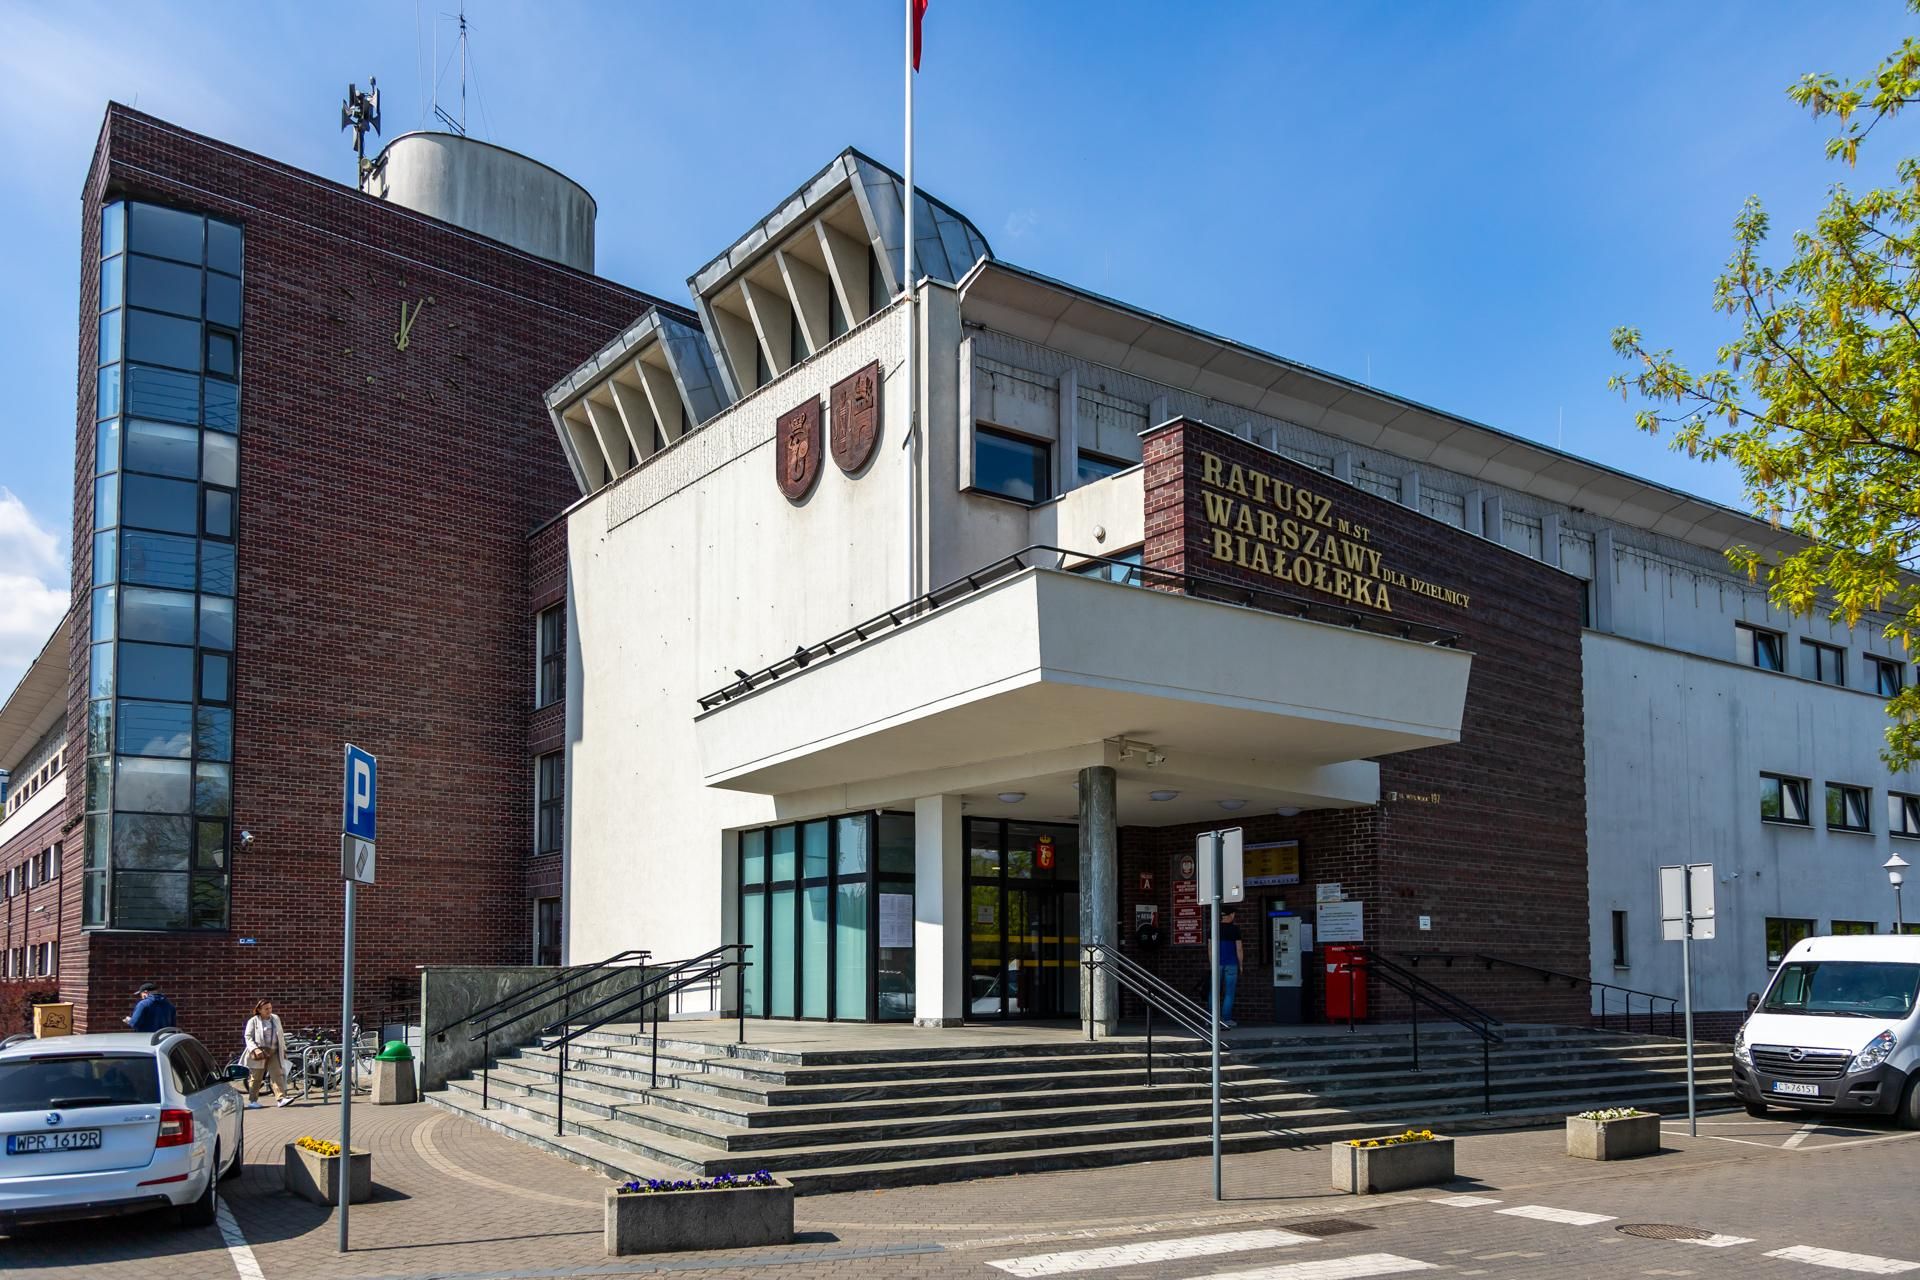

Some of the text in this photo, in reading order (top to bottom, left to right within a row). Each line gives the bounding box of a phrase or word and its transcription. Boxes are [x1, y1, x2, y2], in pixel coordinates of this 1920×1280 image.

[1200, 450, 1333, 528] RATUSZ
[1201, 489, 1471, 609] WARSZAWY DLA DZIELNICY
[353, 757, 371, 825] P
[17, 1132, 99, 1151] WPR 1619R
